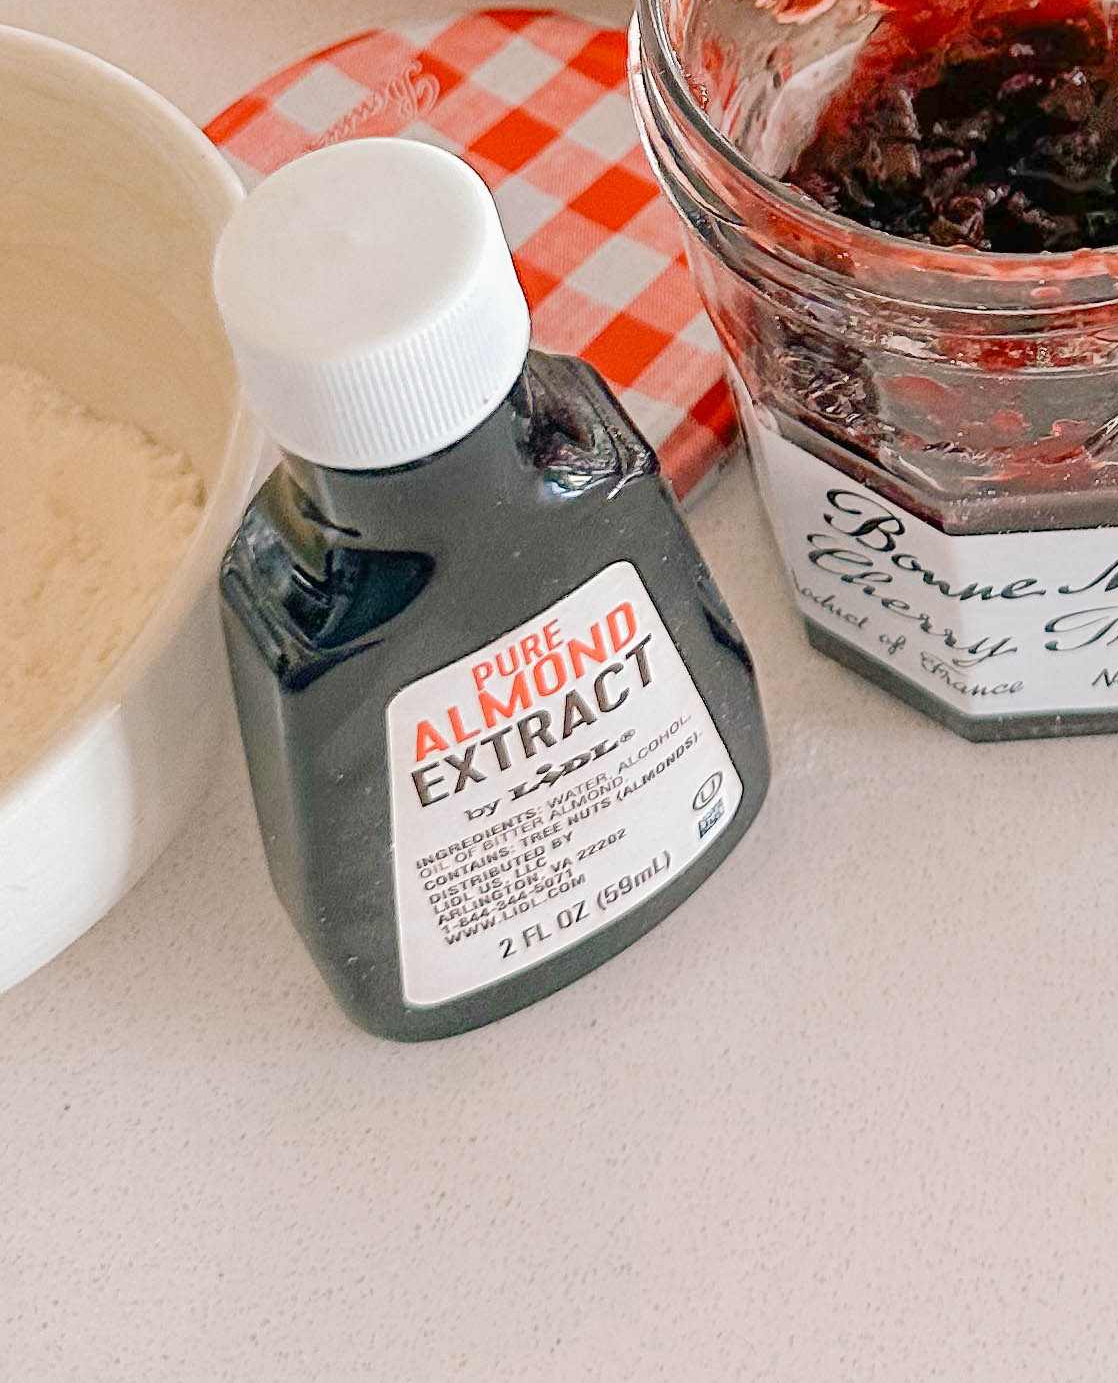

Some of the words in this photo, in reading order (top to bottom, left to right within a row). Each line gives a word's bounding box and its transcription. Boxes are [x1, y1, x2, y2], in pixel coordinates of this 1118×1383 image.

[824, 488, 1046, 601] Bonne
[807, 531, 1017, 668] Cherry
[415, 601, 637, 762] ALMOND
[472, 618, 564, 691] PURE
[879, 633, 907, 655] of
[920, 651, 1024, 697] France
[411, 633, 652, 807] EXTRACT
[416, 806, 541, 869] INGREDIENTS:
[547, 772, 613, 809] WATER,
[424, 845, 515, 890] CONTAINS:
[520, 822, 563, 847] TREE
[568, 797, 612, 825] NUTS
[616, 730, 702, 802] (ALMONDS).
[464, 798, 500, 820] by
[420, 860, 450, 878] OIL
[455, 847, 477, 863] OF
[483, 816, 544, 851] BITTER
[429, 845, 545, 905] DISTRIBUTED
[551, 831, 573, 850] BY
[550, 857, 573, 873] VA
[576, 828, 626, 861] 22202
[433, 892, 473, 915] LIDL
[515, 856, 547, 878] LLC
[441, 868, 573, 934] 1-844-344-5071
[444, 873, 586, 945] WWW.LIDL.COM
[499, 938, 517, 959] 2
[522, 923, 552, 948] FL
[556, 900, 590, 930] OZ
[596, 850, 672, 911] (59mL)
